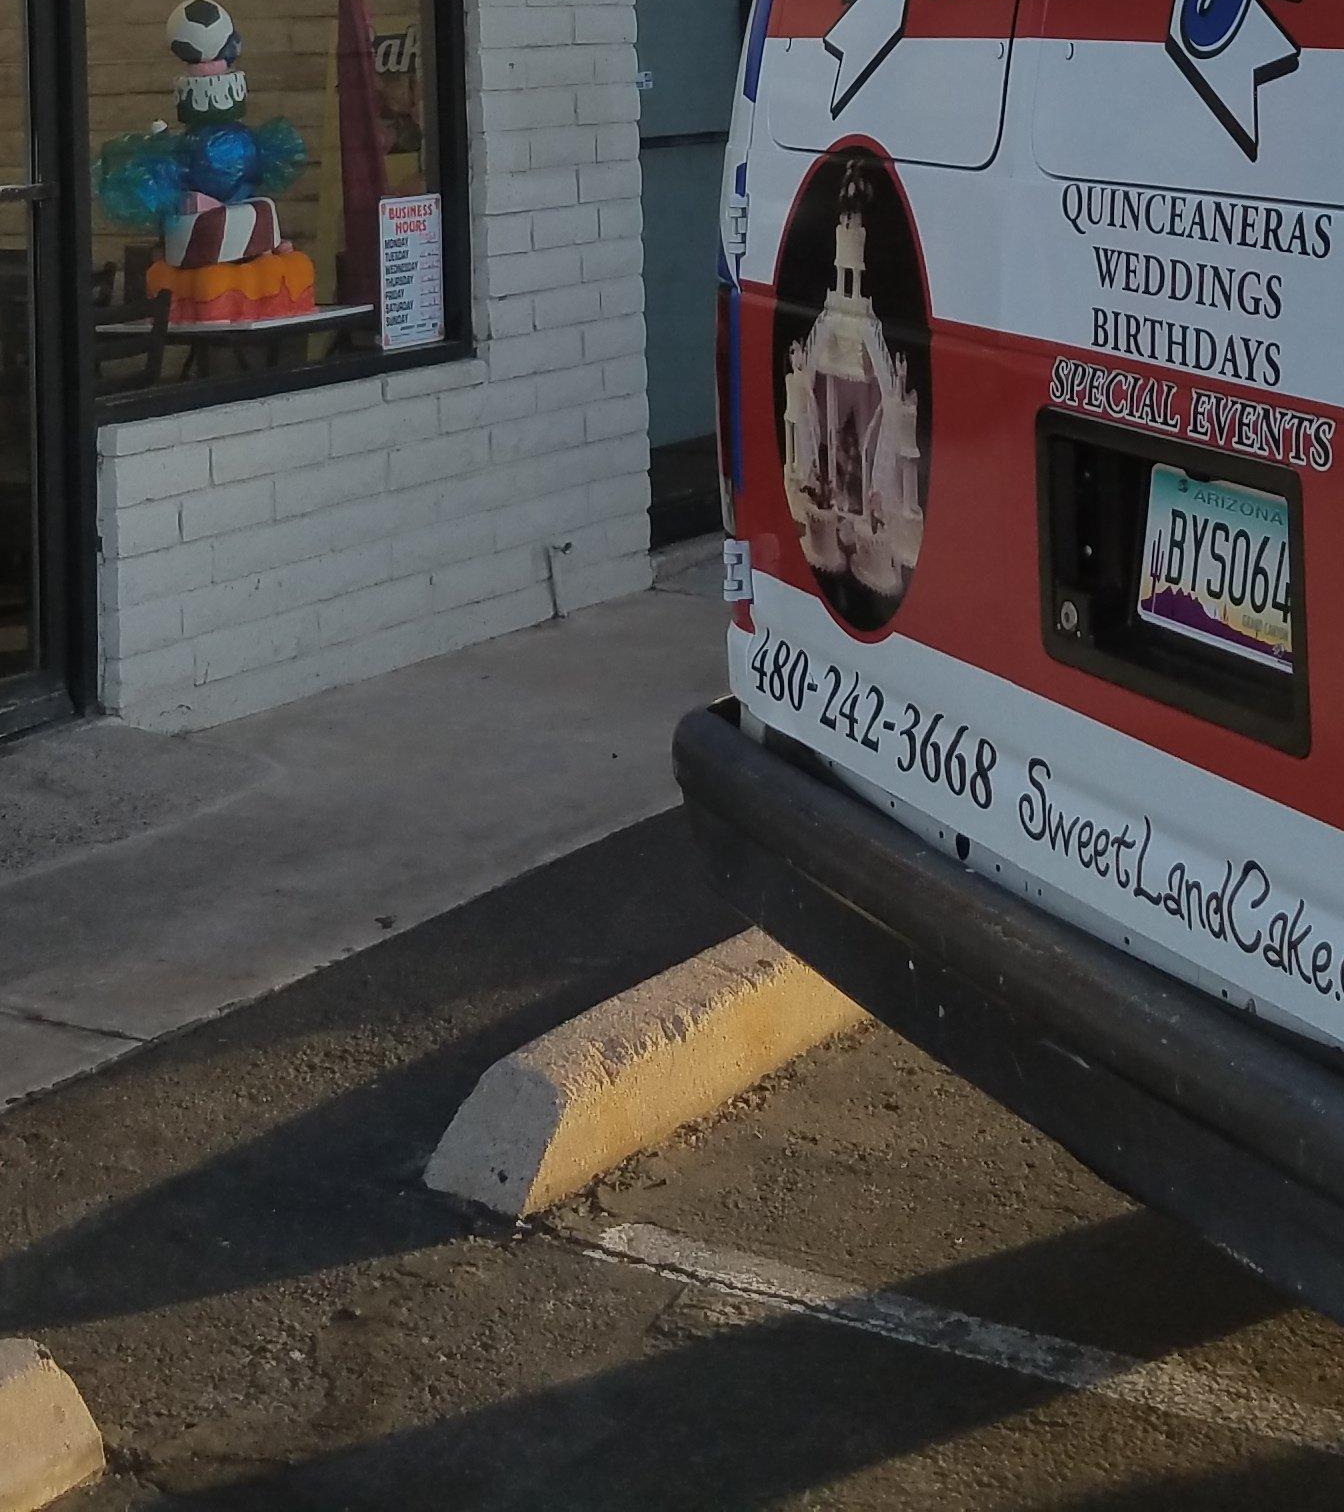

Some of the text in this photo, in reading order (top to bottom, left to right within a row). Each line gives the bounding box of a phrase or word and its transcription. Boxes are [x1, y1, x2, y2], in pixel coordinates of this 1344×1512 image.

[388, 204, 433, 220] BUSINESS
[395, 220, 426, 235] HOURS
[1061, 183, 1332, 260] QUINCEANERAS
[1092, 245, 1282, 319] WEDDINGS
[1090, 307, 1281, 387] BIRTHDAYS
[1050, 355, 1335, 471] SPECIAL EVENTS
[1194, 489, 1284, 526] ARIZONA
[750, 627, 997, 808] 480-242-3668
